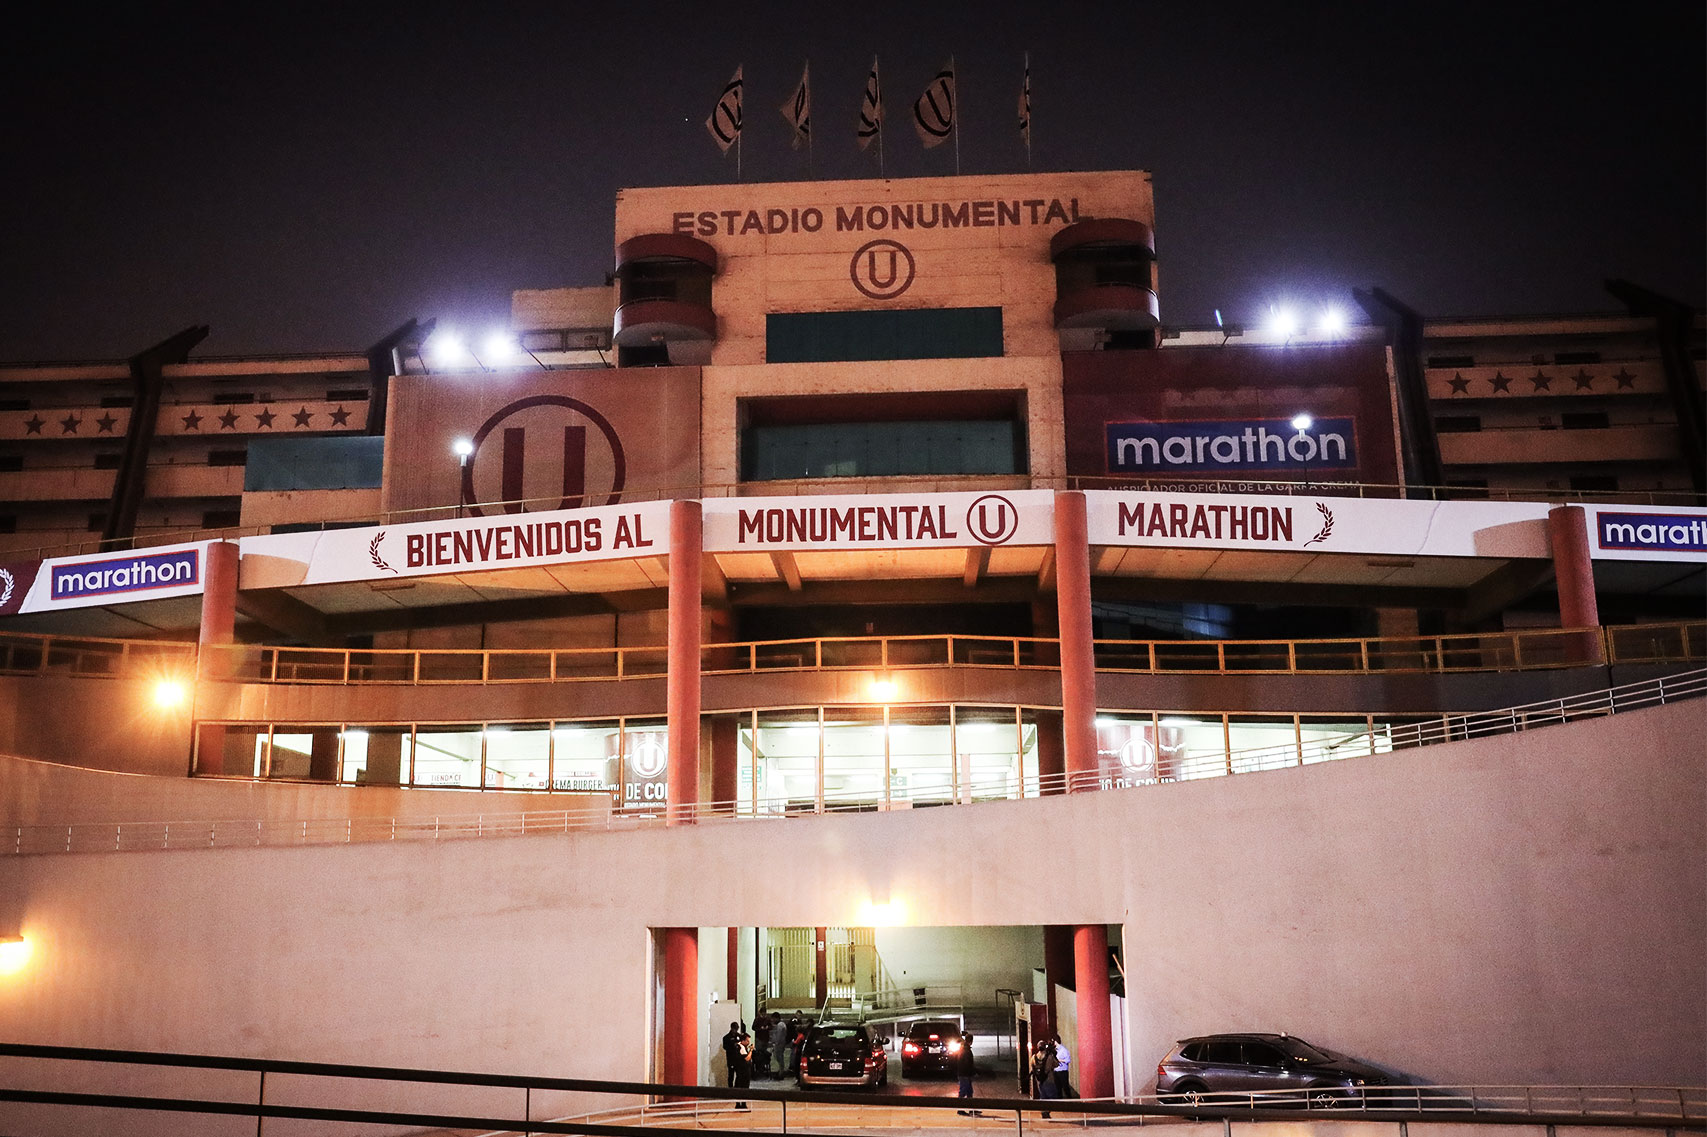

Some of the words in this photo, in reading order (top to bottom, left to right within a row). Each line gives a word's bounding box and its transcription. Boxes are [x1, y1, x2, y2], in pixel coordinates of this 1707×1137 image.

[672, 207, 824, 238] ESTADIO
[836, 198, 1095, 232] MONUMENTAL
[868, 250, 898, 289] U
[1116, 427, 1347, 465] marathon
[1189, 483, 1236, 493] OFICAL
[1238, 483, 1255, 492] DE
[1257, 483, 1273, 493] LA
[406, 517, 602, 568] BIENVENIDOS
[613, 513, 654, 549] AL
[738, 505, 958, 543] MONUMENTAL
[978, 504, 1006, 539] U
[1117, 501, 1293, 542] MARATHON
[57, 560, 192, 593] marathon
[625, 783, 642, 800] DE
